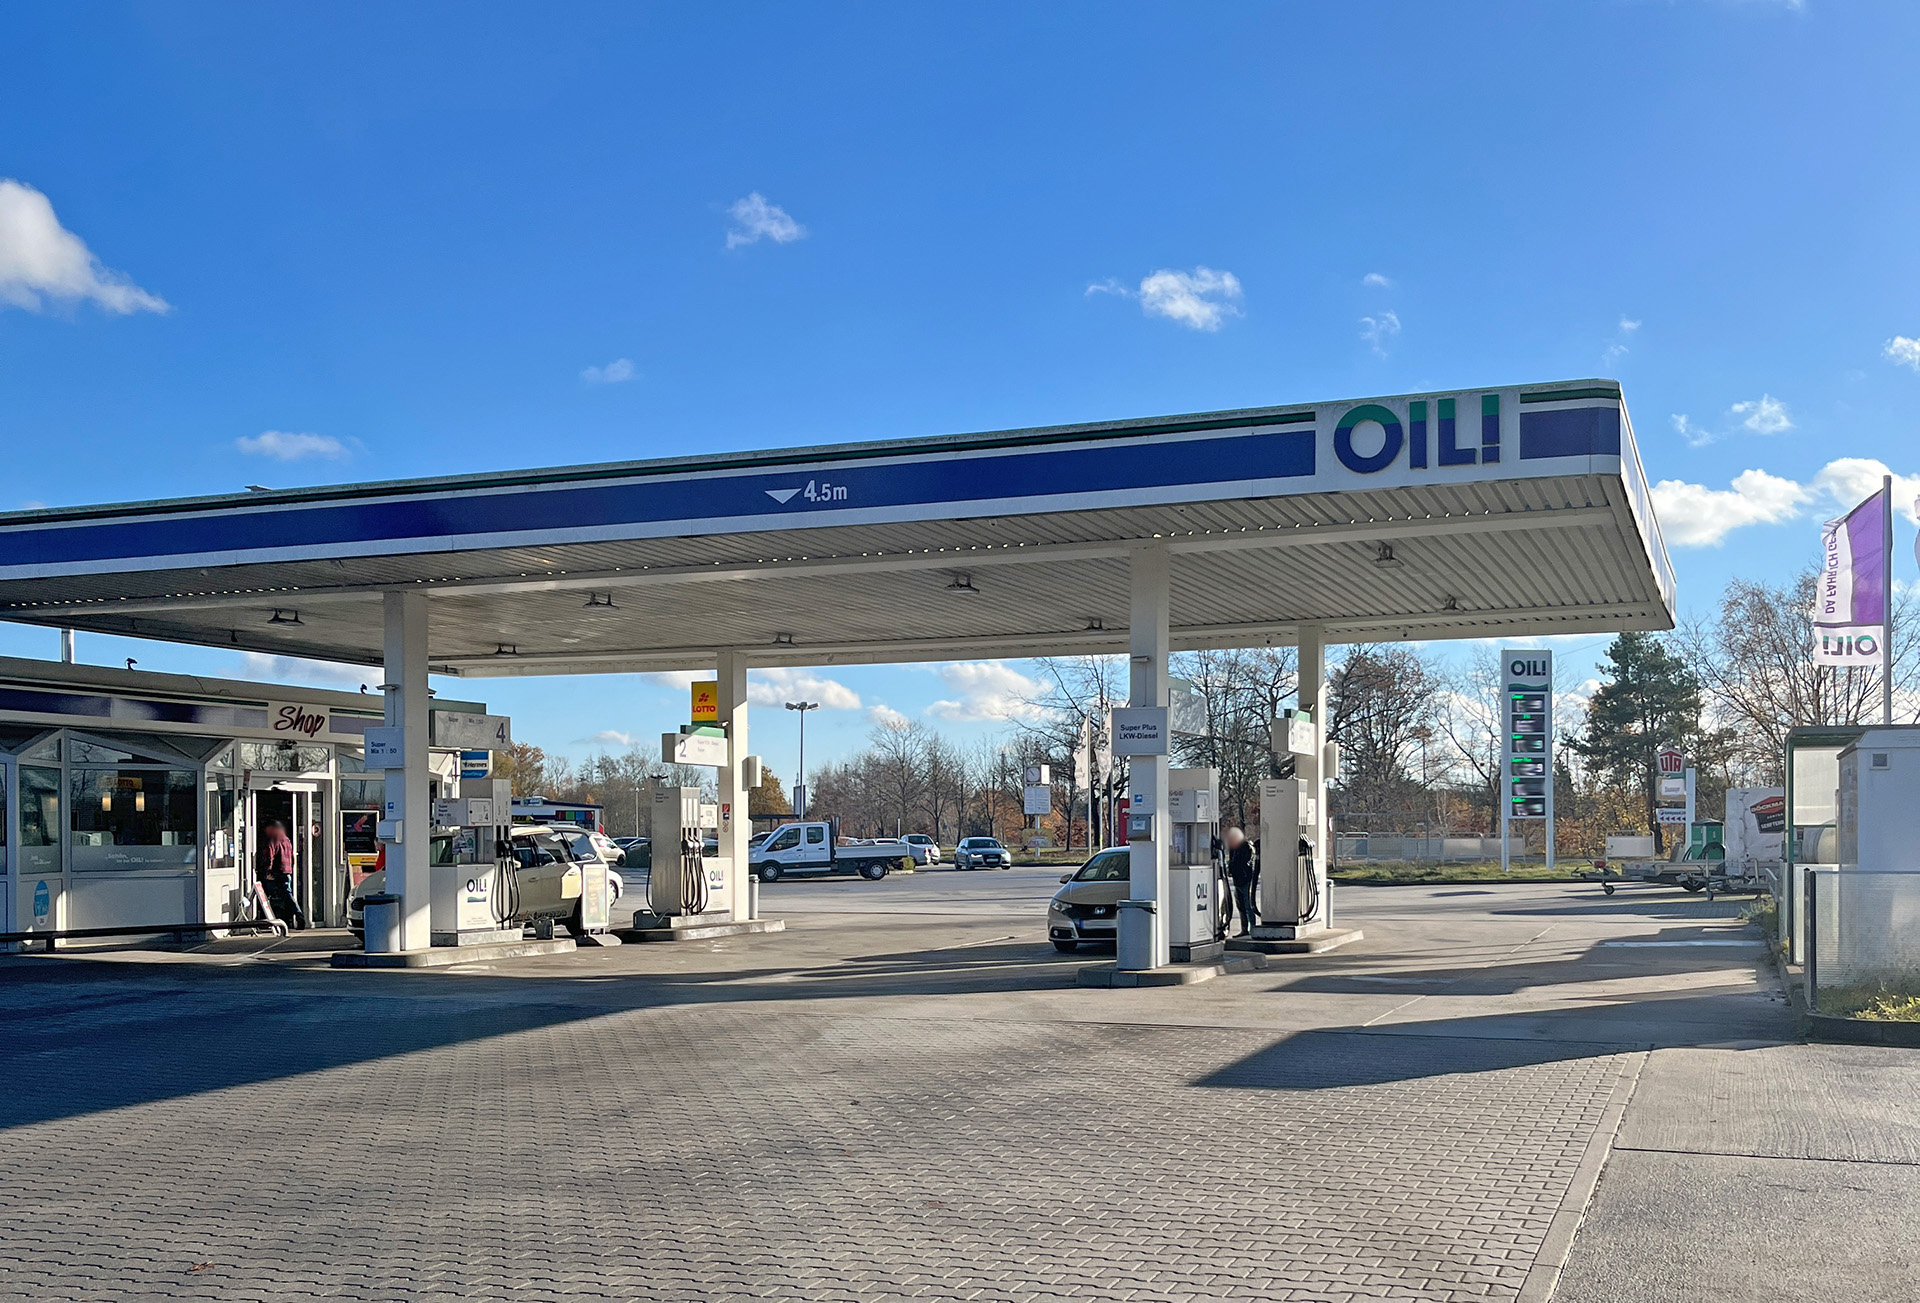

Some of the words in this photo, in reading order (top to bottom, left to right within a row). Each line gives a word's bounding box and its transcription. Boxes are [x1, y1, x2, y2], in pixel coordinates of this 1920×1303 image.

[1333, 394, 1500, 474] OIL!
[803, 480, 847, 502] 4.5m
[1510, 660, 1546, 676] OIL!
[692, 705, 716, 713] LOTTO
[273, 705, 325, 738] Shop
[1120, 724, 1141, 732] Super
[496, 722, 506, 744] 4
[1119, 732, 1158, 740] LKW-Diesel
[679, 739, 686, 757] 2
[1751, 801, 1784, 812] BÖCKMA
[709, 870, 724, 881] OIL!
[466, 878, 487, 893] OIL!
[1196, 883, 1208, 900] OIL!
